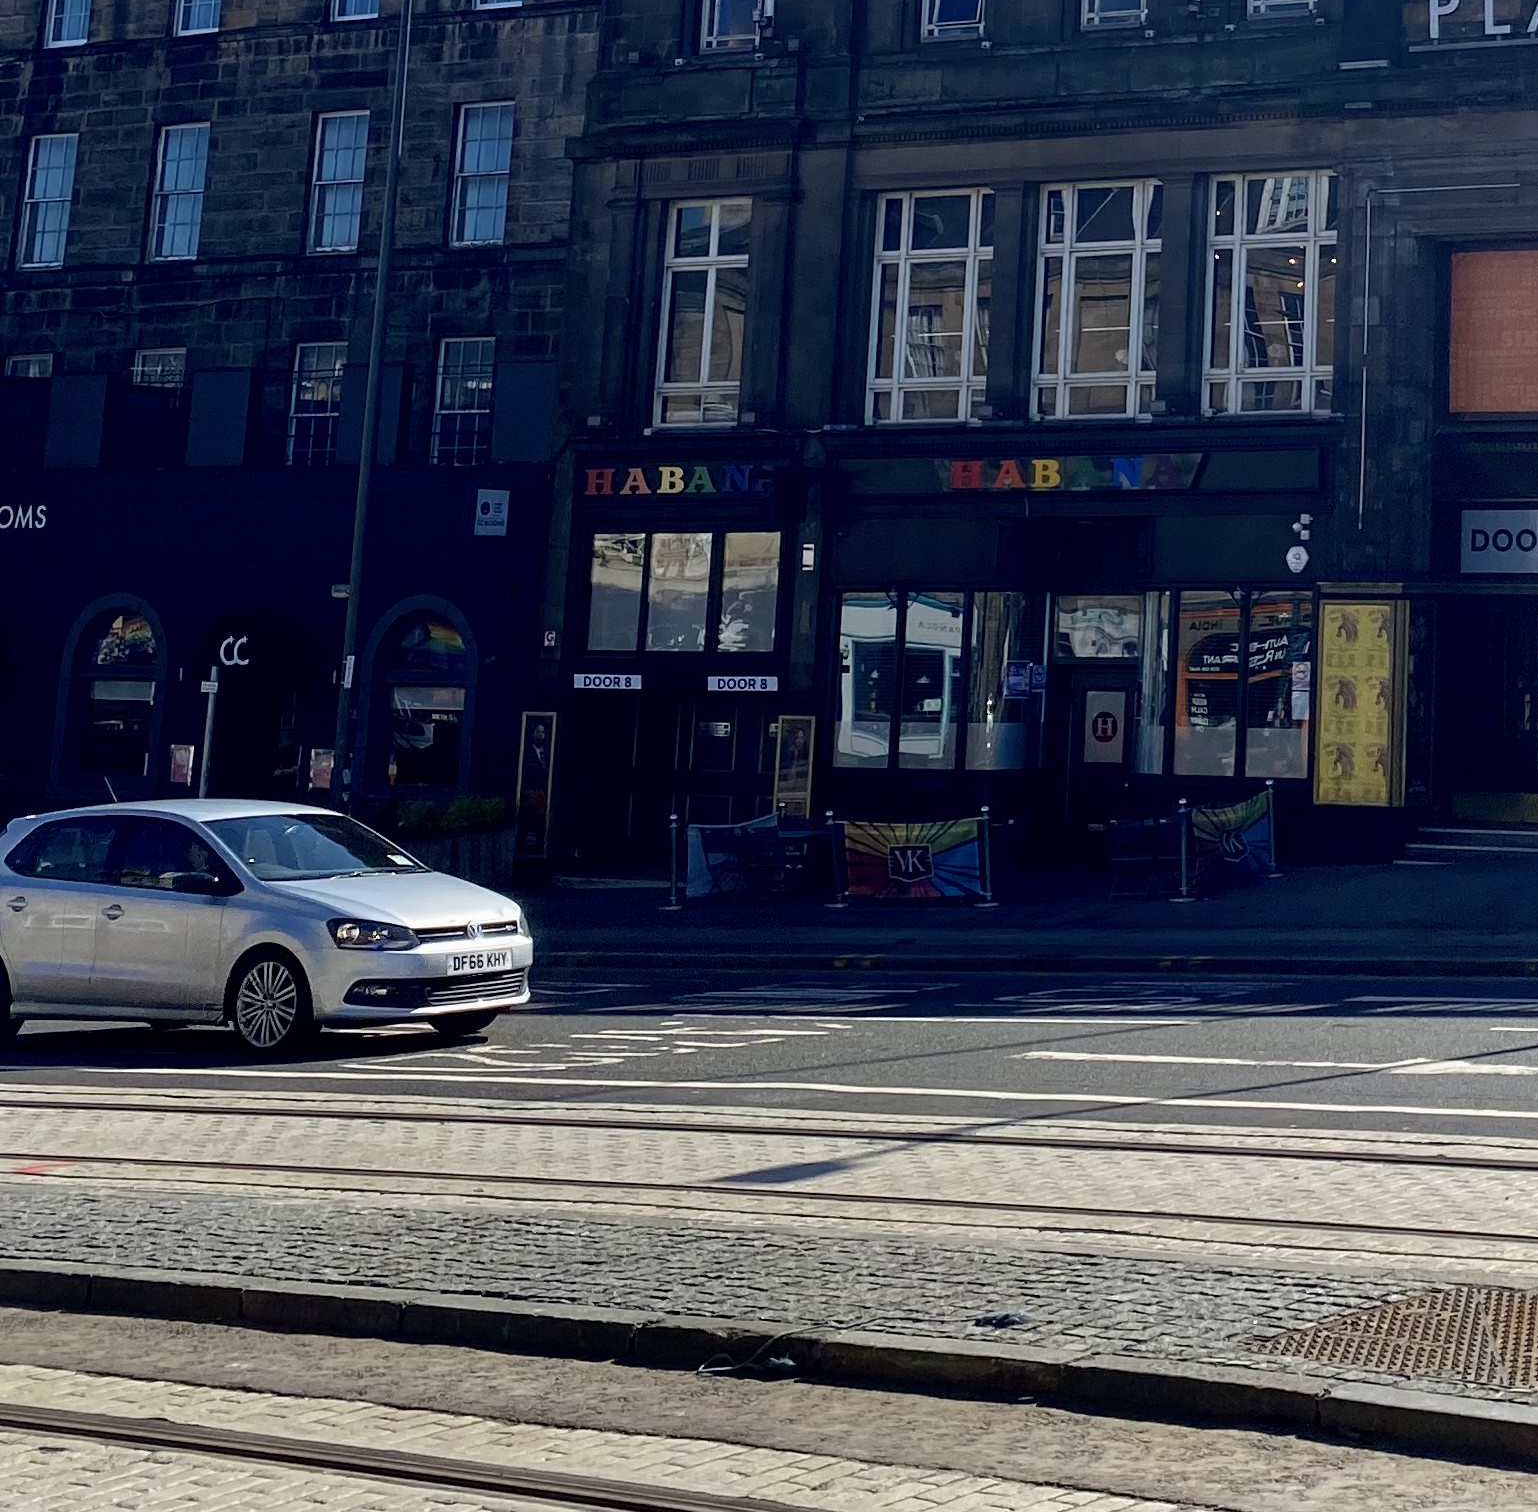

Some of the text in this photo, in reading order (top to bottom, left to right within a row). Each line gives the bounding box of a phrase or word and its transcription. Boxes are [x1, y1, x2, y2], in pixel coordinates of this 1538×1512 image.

[951, 455, 1182, 489] HABANA
[0, 504, 47, 529] OMS
[583, 676, 632, 688] DOOR 8
[717, 678, 767, 689] DOOR 8
[1095, 717, 1115, 737] H
[894, 849, 926, 873] VK
[453, 951, 507, 971] DF66 KHY
